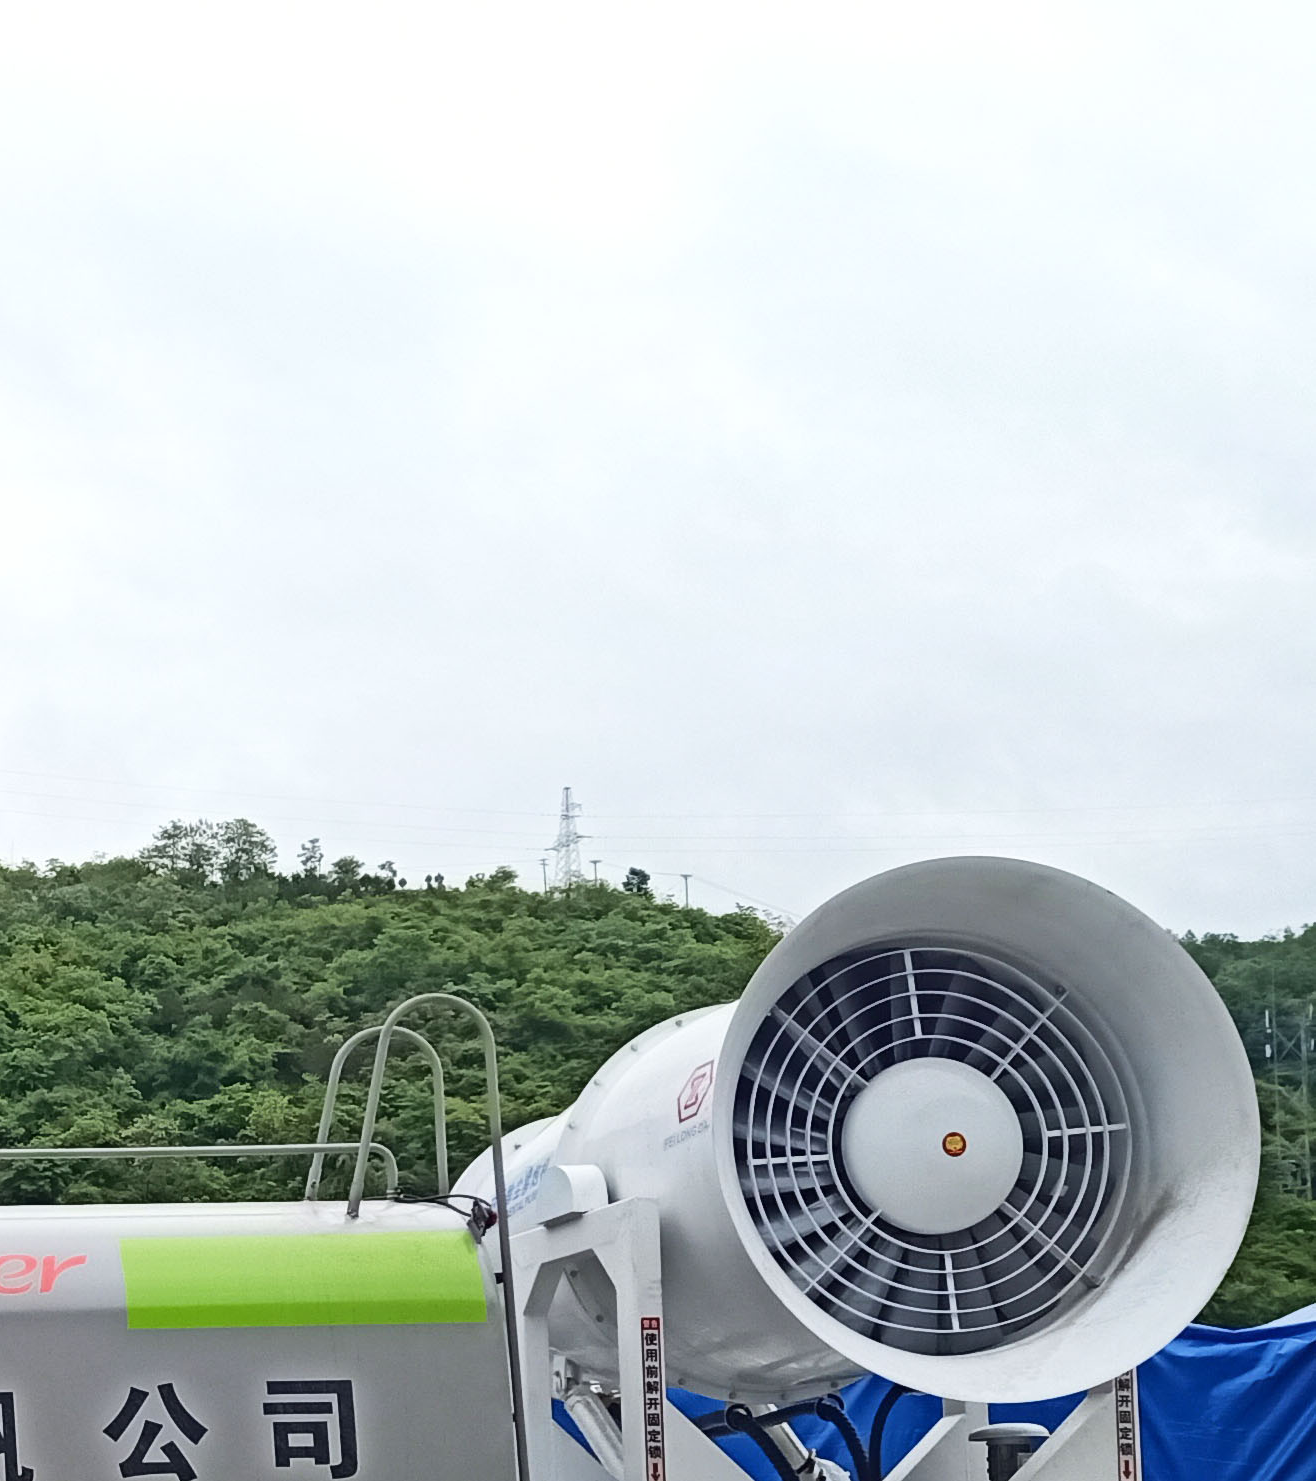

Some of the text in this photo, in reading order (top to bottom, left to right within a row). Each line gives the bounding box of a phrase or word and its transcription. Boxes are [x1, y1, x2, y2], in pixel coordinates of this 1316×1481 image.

[644, 1332, 662, 1460] 使用前解开固定锁
[1117, 1371, 1133, 1456] 解开固定锁
